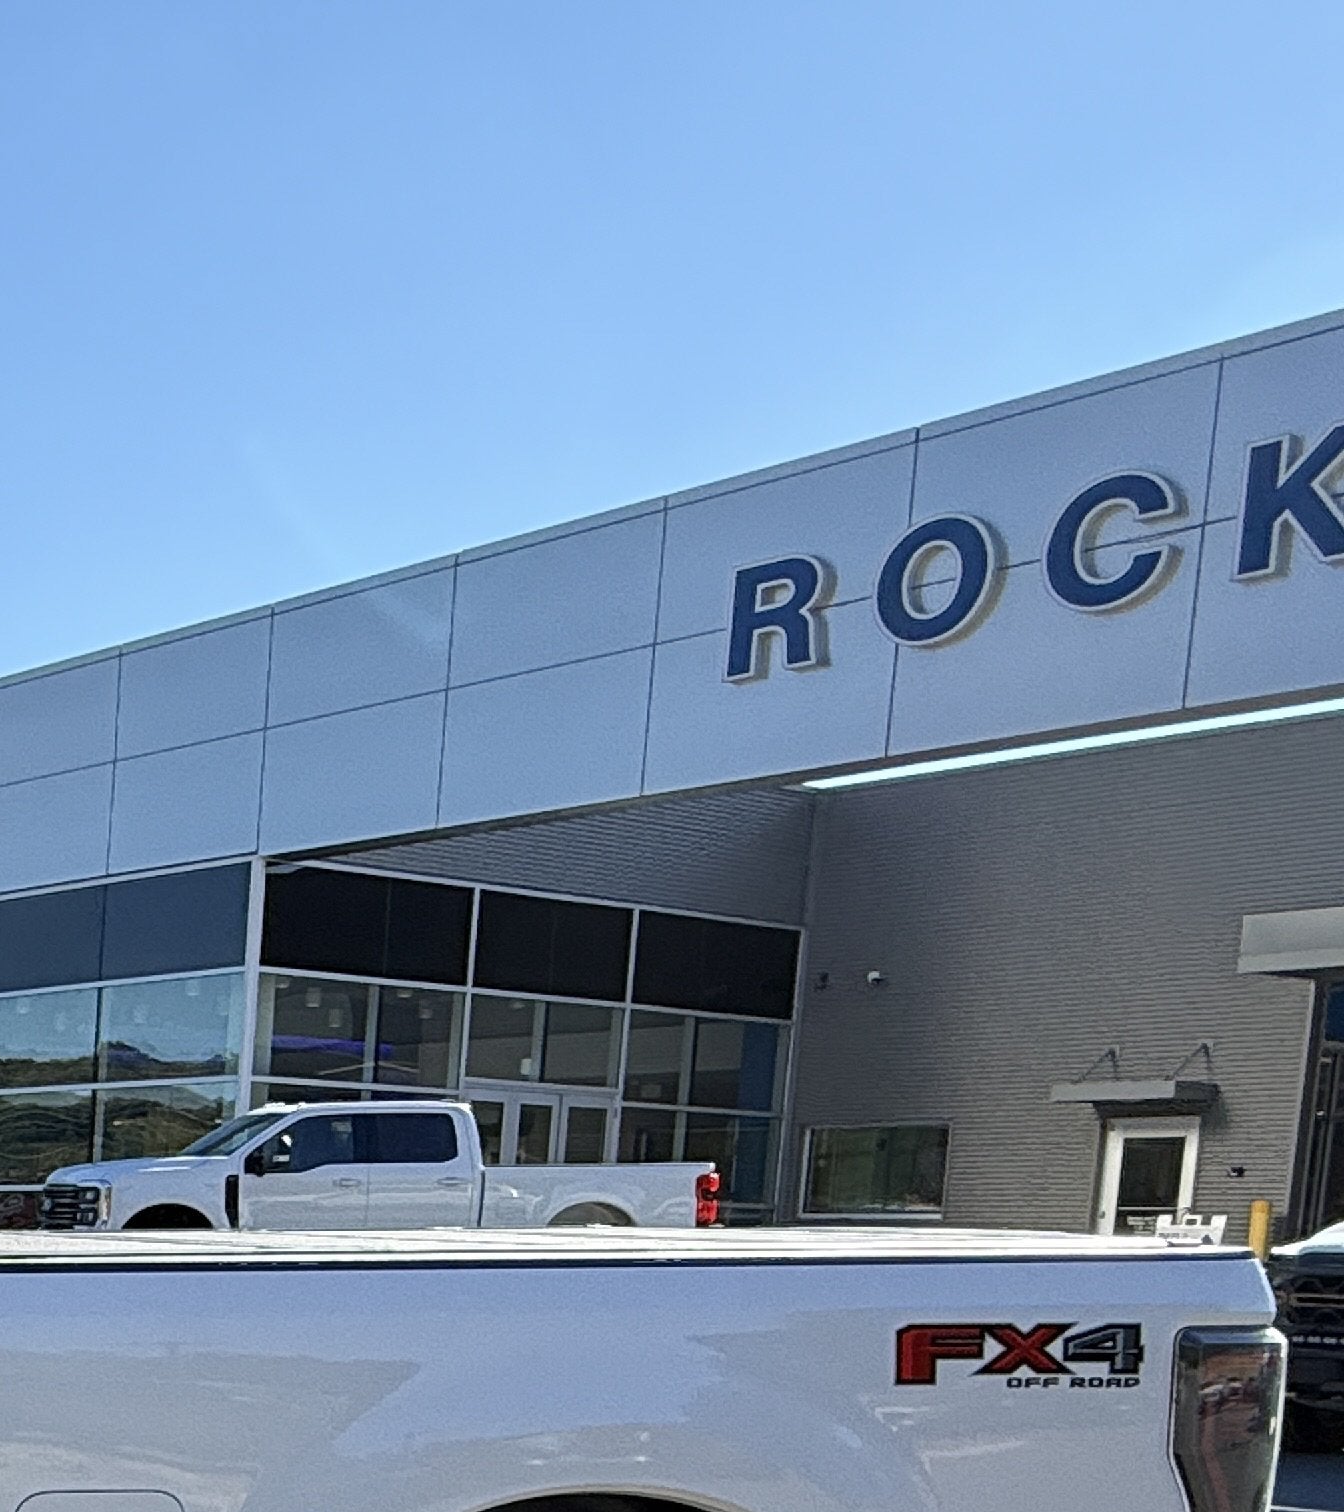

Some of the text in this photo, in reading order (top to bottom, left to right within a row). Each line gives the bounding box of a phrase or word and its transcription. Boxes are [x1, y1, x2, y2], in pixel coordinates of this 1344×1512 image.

[722, 422, 1344, 684] ROCK
[895, 1321, 1144, 1386] FX4
[1006, 1376, 1141, 1389] OFF ROAD
